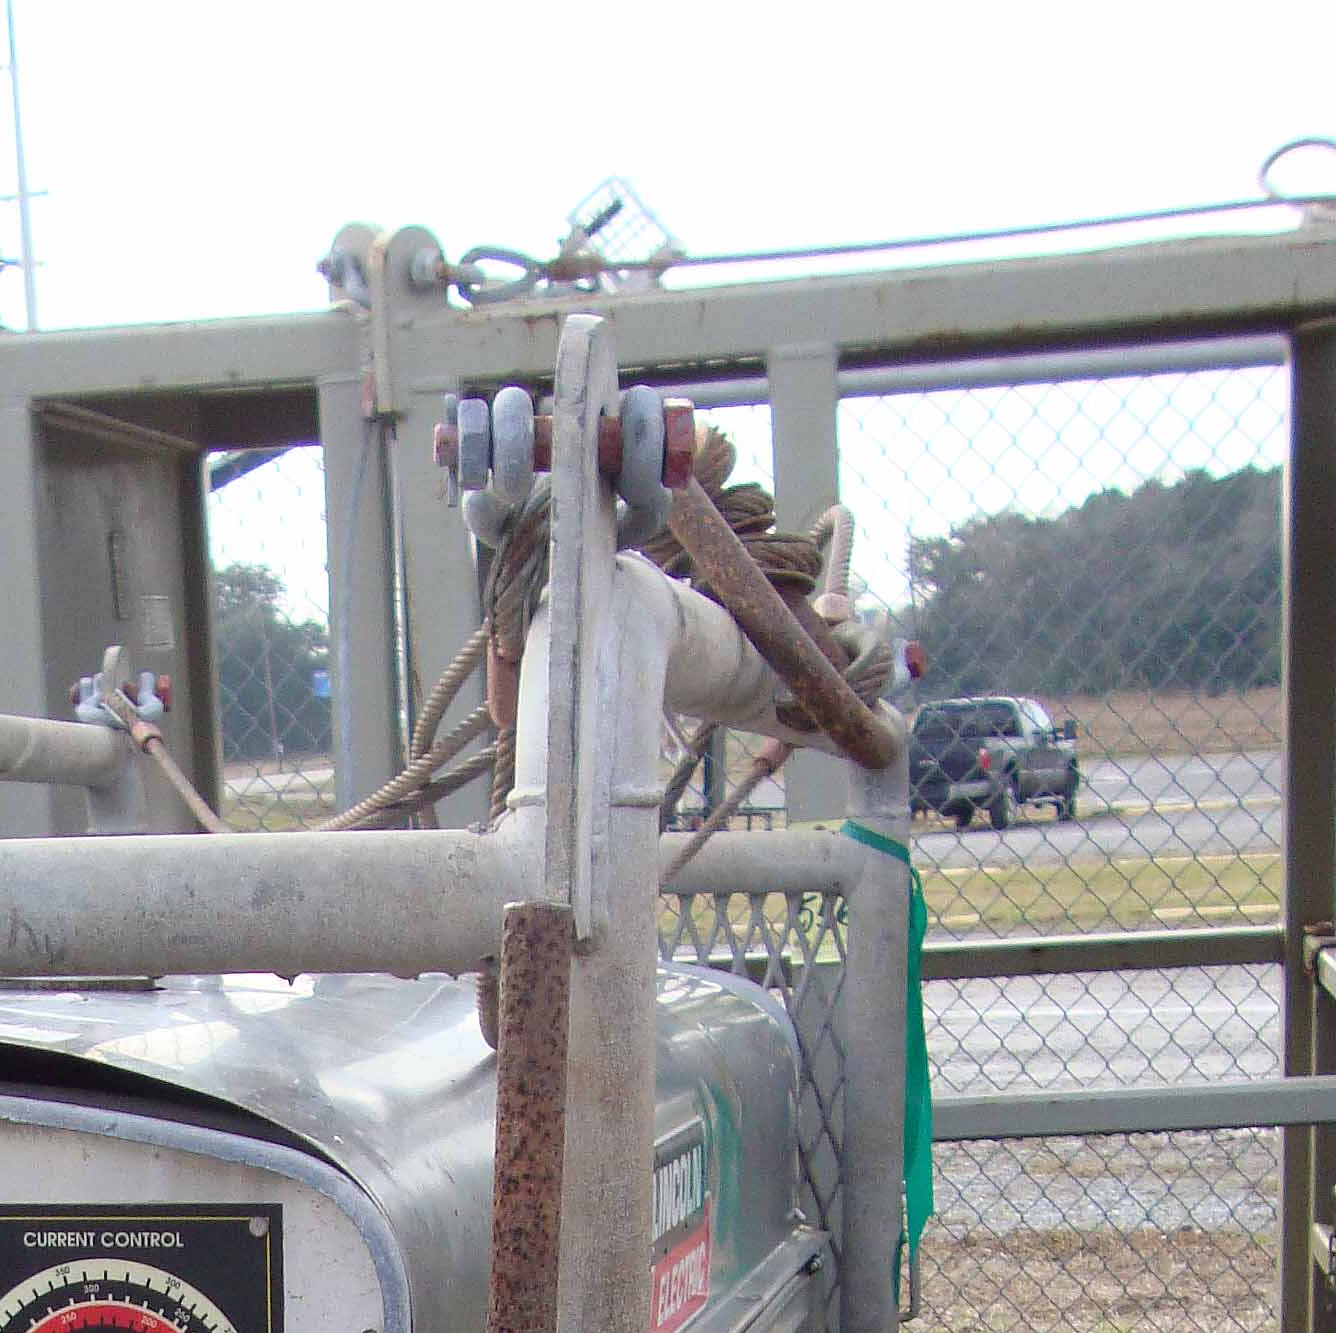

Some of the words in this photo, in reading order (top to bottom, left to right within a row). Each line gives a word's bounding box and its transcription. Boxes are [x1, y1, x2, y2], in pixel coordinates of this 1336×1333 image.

[23, 1232, 96, 1248] CURRENT
[100, 1231, 185, 1248] CONTROL
[165, 1277, 181, 1290] 300
[656, 1241, 706, 1328] ELECTRIC
